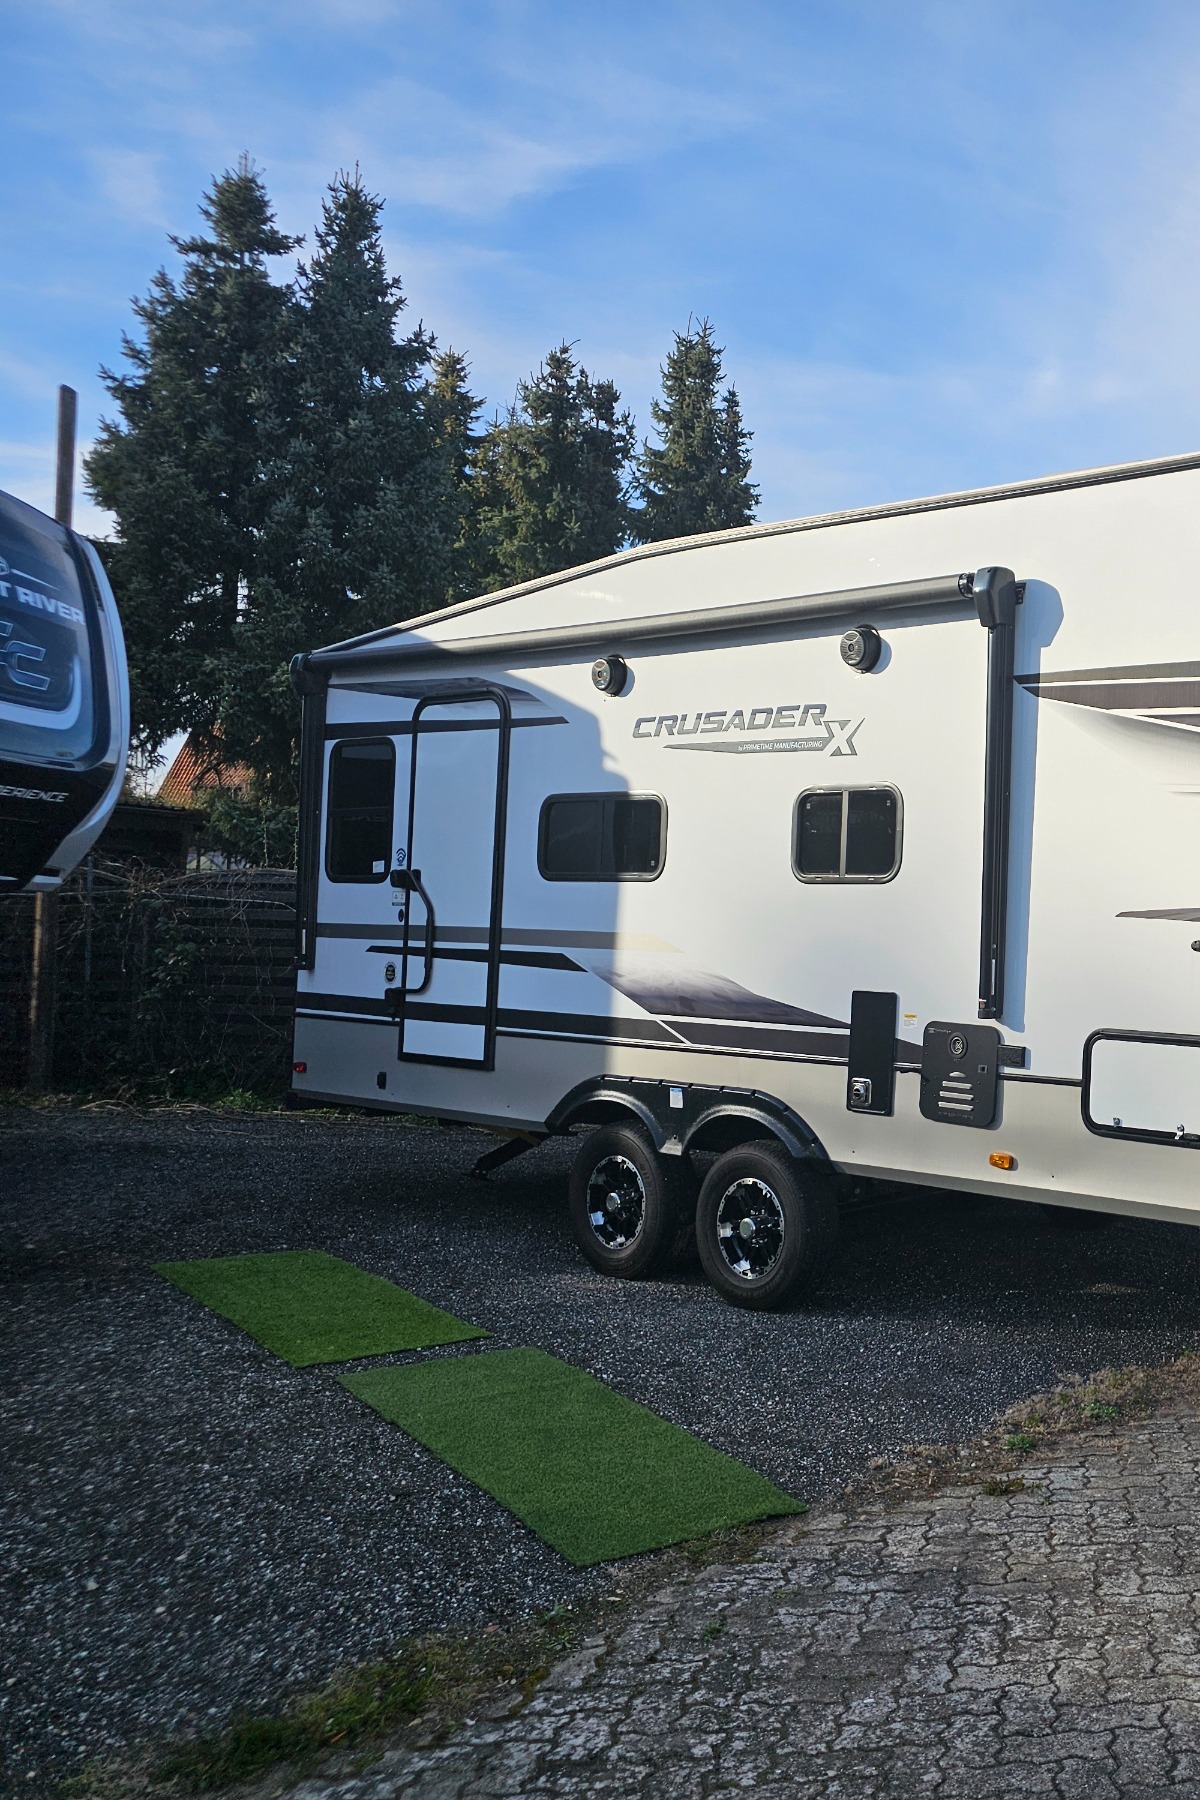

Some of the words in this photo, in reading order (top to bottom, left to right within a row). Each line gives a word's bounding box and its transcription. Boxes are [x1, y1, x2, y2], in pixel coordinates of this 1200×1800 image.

[15, 585, 86, 625] RIVER
[632, 703, 828, 739] CRUSADER
[743, 742, 774, 751] PRIMETIME
[773, 740, 823, 750] MANUFACTURING
